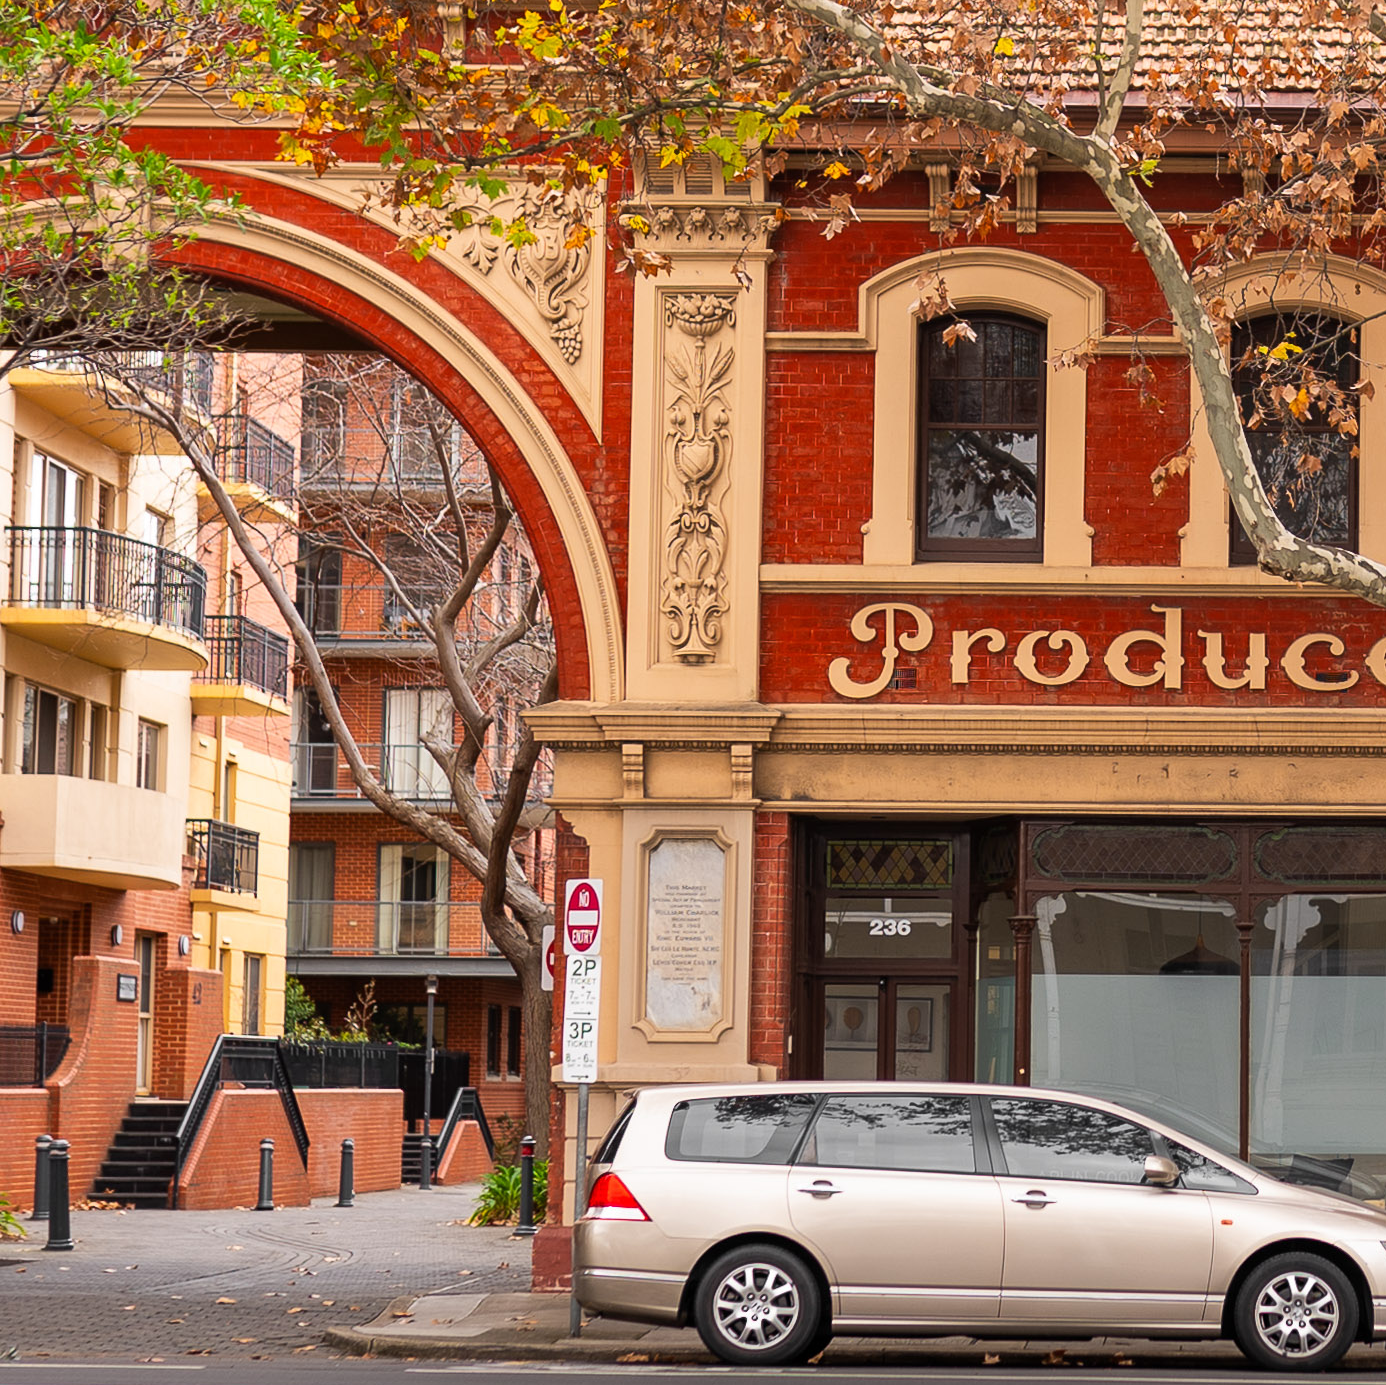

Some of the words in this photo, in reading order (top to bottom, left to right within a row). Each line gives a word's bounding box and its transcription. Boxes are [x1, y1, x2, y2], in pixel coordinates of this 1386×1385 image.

[579, 890, 590, 908] NO
[869, 919, 912, 936] 236
[572, 929, 594, 945] ENTRY
[572, 959, 597, 976] 2P
[569, 1022, 593, 1039] 3P
